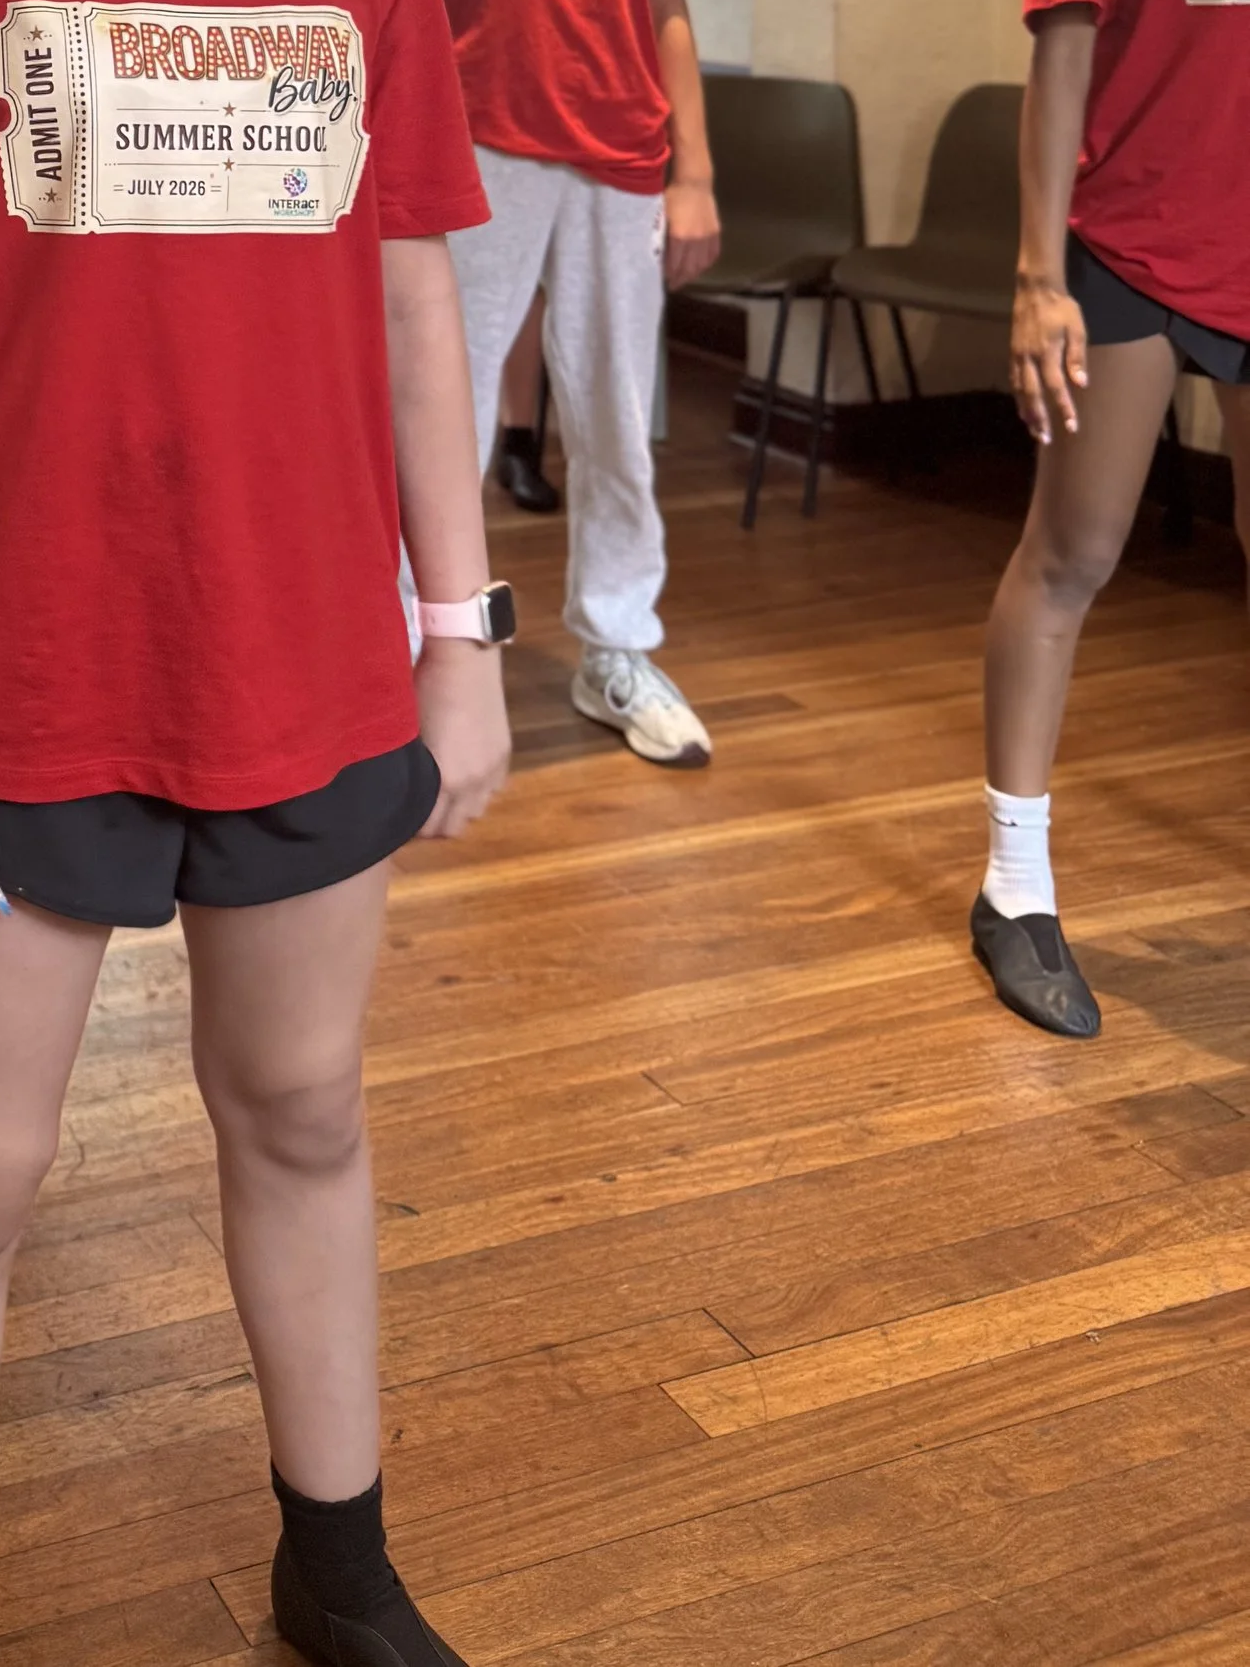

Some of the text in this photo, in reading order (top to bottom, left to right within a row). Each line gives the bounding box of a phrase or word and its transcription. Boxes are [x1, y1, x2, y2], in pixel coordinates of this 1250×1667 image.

[109, 22, 352, 82] BROADWAY
[24, 47, 63, 182] ADMIT ONE
[268, 66, 358, 122] Baby!
[115, 123, 234, 151] SUMMER
[128, 179, 206, 196] JULY 2026
